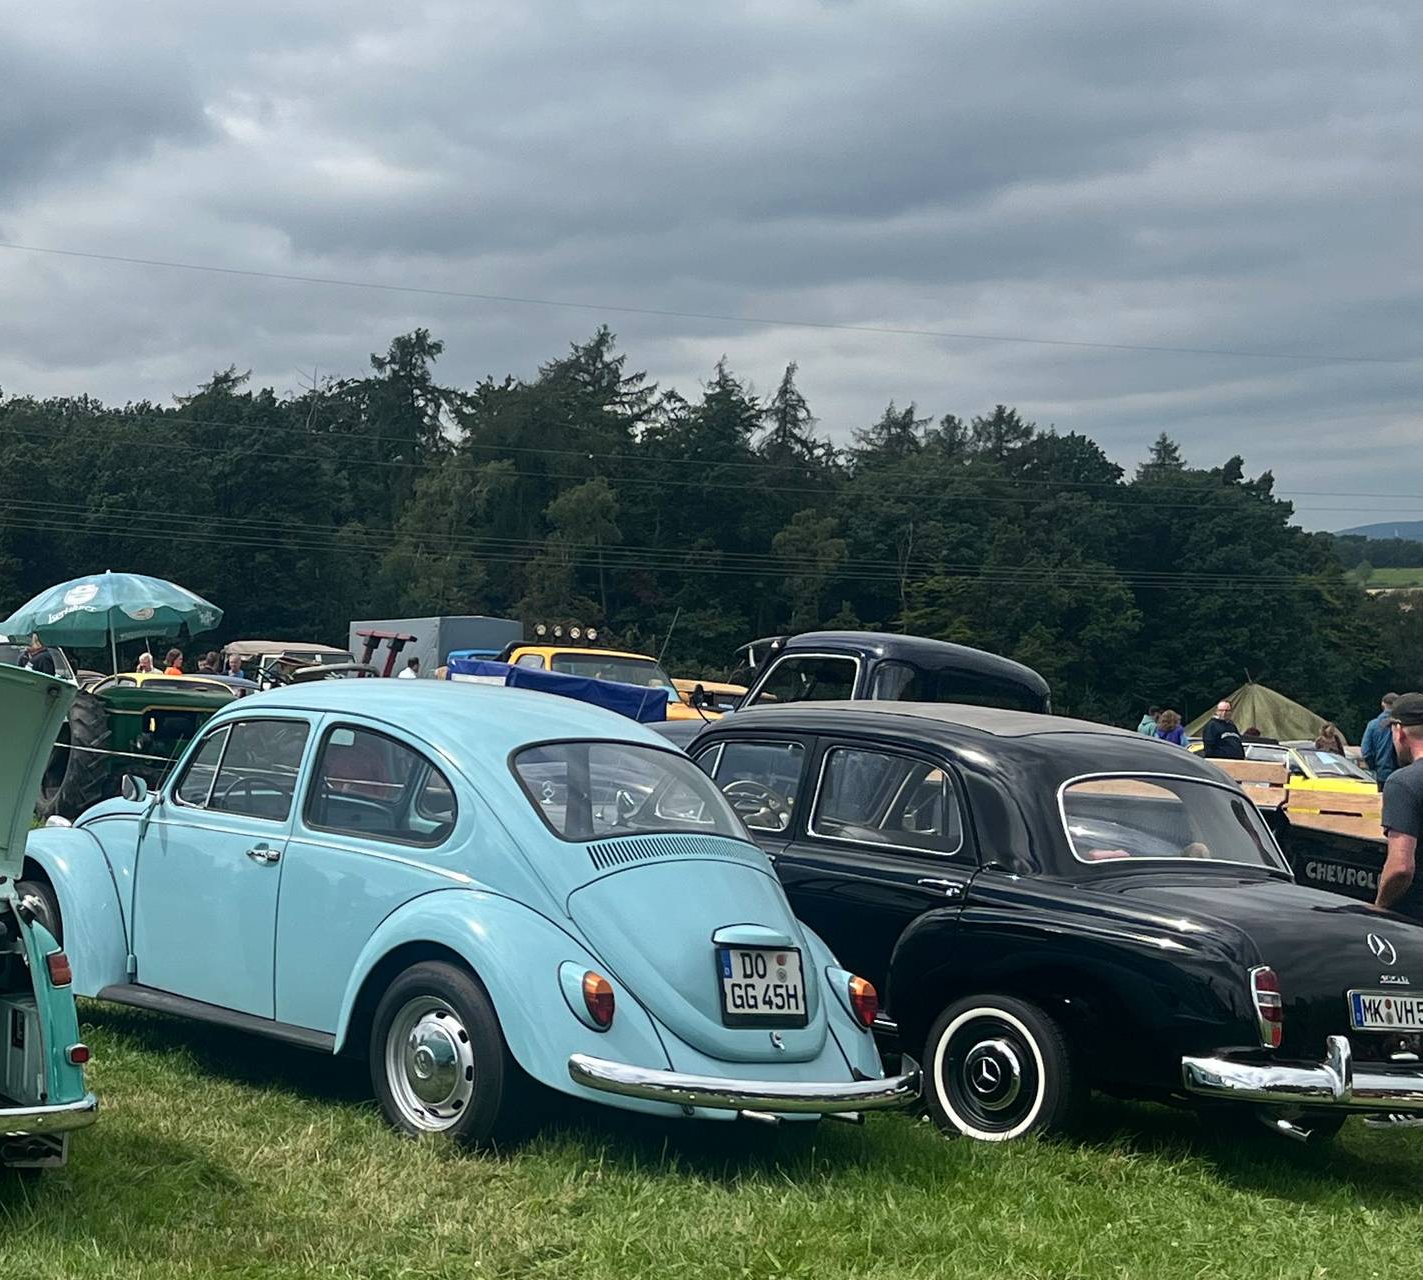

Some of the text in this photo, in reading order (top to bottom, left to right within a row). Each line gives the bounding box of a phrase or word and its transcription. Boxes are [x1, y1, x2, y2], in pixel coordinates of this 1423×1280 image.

[740, 953, 766, 979] DO
[731, 983, 799, 1010] GG 45H
[1362, 999, 1384, 1023] MK
